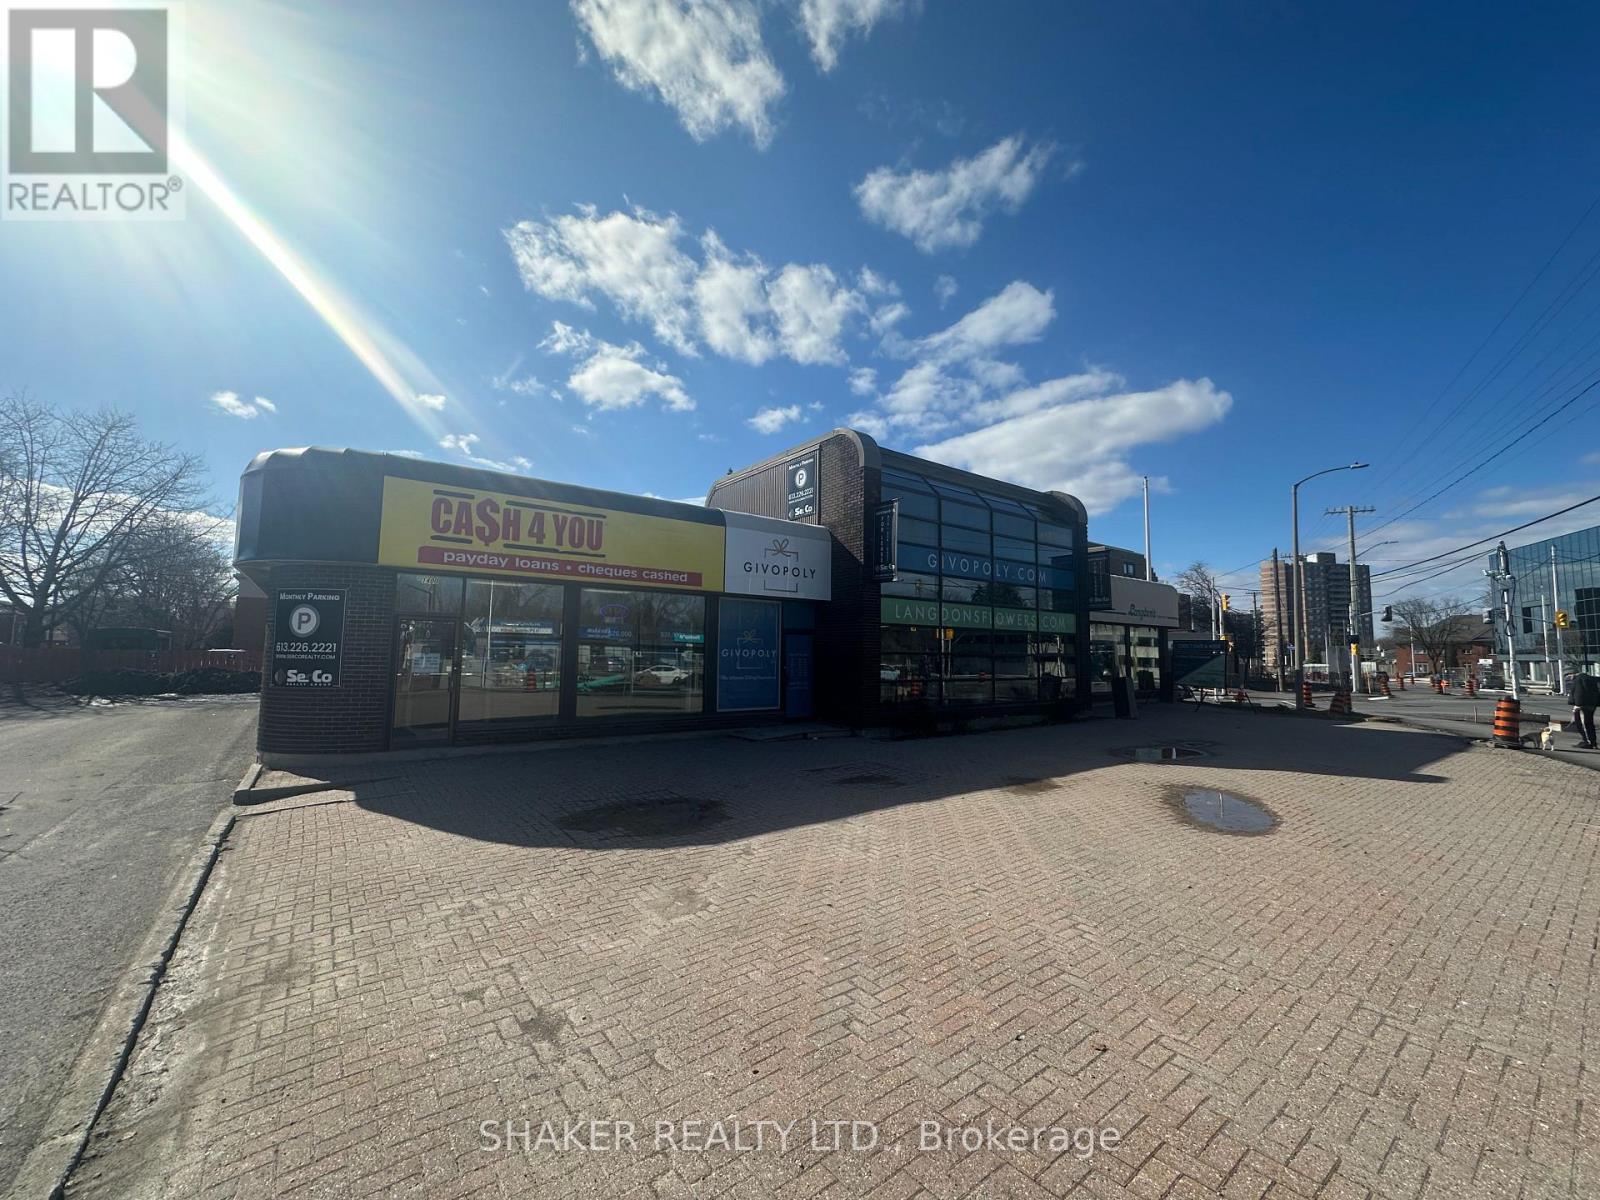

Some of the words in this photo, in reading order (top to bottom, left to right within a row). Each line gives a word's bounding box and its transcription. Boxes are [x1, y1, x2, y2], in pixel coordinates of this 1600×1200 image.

[527, 511, 546, 544] 4
[552, 514, 604, 551] YOU
[443, 551, 508, 567] payday
[515, 557, 559, 571] loans
[578, 563, 637, 579] cheques
[642, 569, 688, 583] cashed
[743, 561, 816, 580] GIVOPOLY
[276, 642, 337, 652] 613.226.2221
[721, 648, 777, 658] GIVOPOLY
